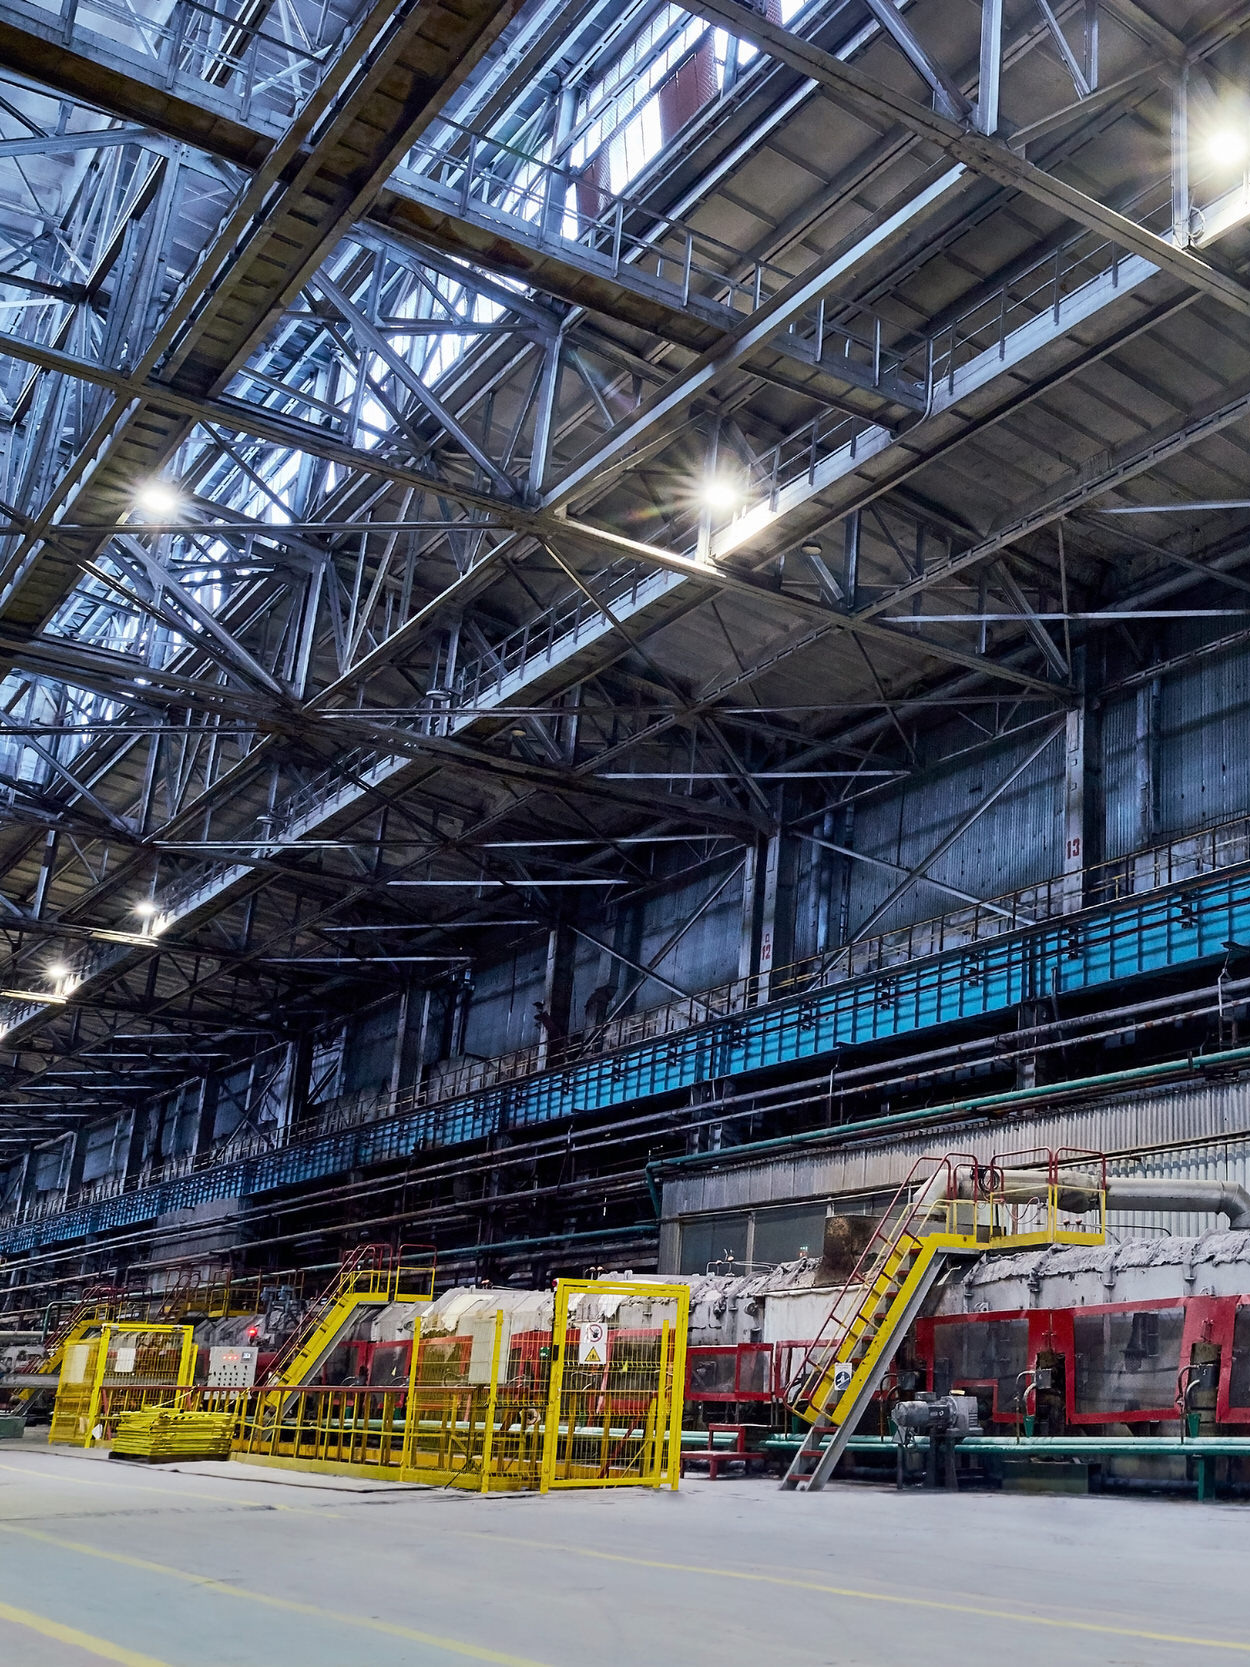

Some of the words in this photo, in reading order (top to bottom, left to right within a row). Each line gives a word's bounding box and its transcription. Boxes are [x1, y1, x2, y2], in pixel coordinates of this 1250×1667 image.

[1067, 838, 1080, 859] 13
[762, 944, 771, 960] 12
[1202, 1368, 1207, 1376] 5
